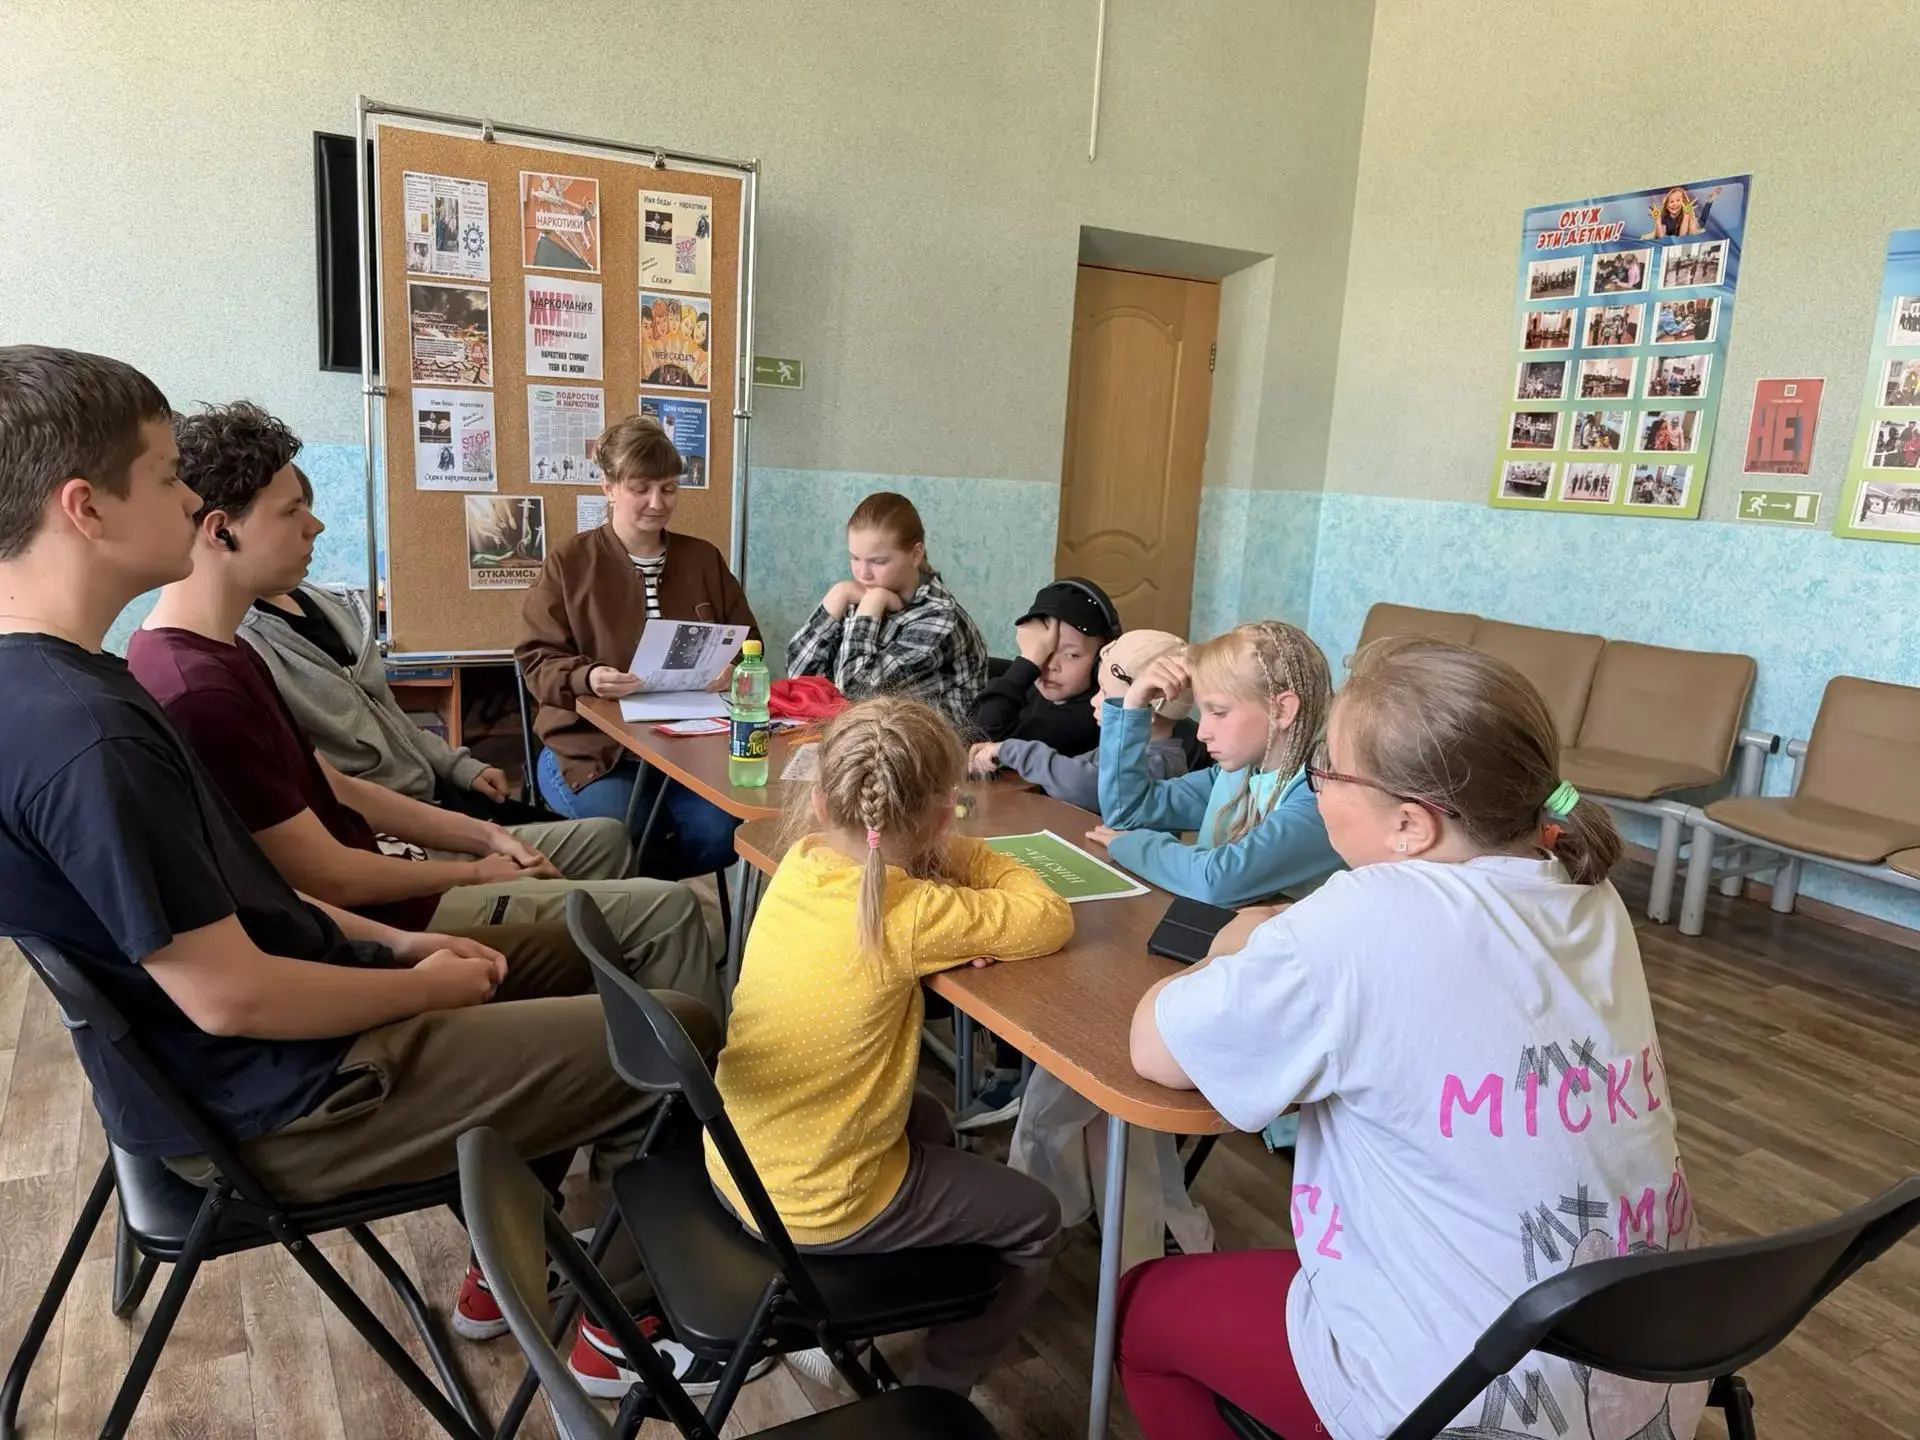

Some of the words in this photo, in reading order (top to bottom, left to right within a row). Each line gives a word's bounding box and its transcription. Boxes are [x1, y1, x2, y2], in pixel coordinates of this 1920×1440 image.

[1560, 210, 1578, 228] ОХ
[1581, 206, 1602, 224] УЖ
[537, 215, 583, 230] НАРКОТИКИ
[1537, 231, 1562, 249] ЭТИ
[1564, 221, 1624, 245] ДЕТКИ!
[531, 297, 593, 312] НАРКОМАНИЯ
[542, 329, 572, 338] СТРАШНАЯ
[573, 331, 587, 339] БЕДА
[541, 350, 567, 360] НАРКОТИКИ
[548, 363, 560, 372] ТЕБЯ
[561, 364, 568, 372] ИЗ
[569, 364, 584, 373] ЖИЗНИ
[556, 391, 600, 401] ПОДРОСТОК
[563, 401, 600, 409] НАРКОТИКИ
[462, 430, 490, 449] STOP
[478, 569, 536, 578] ОТКАЖИСЬ
